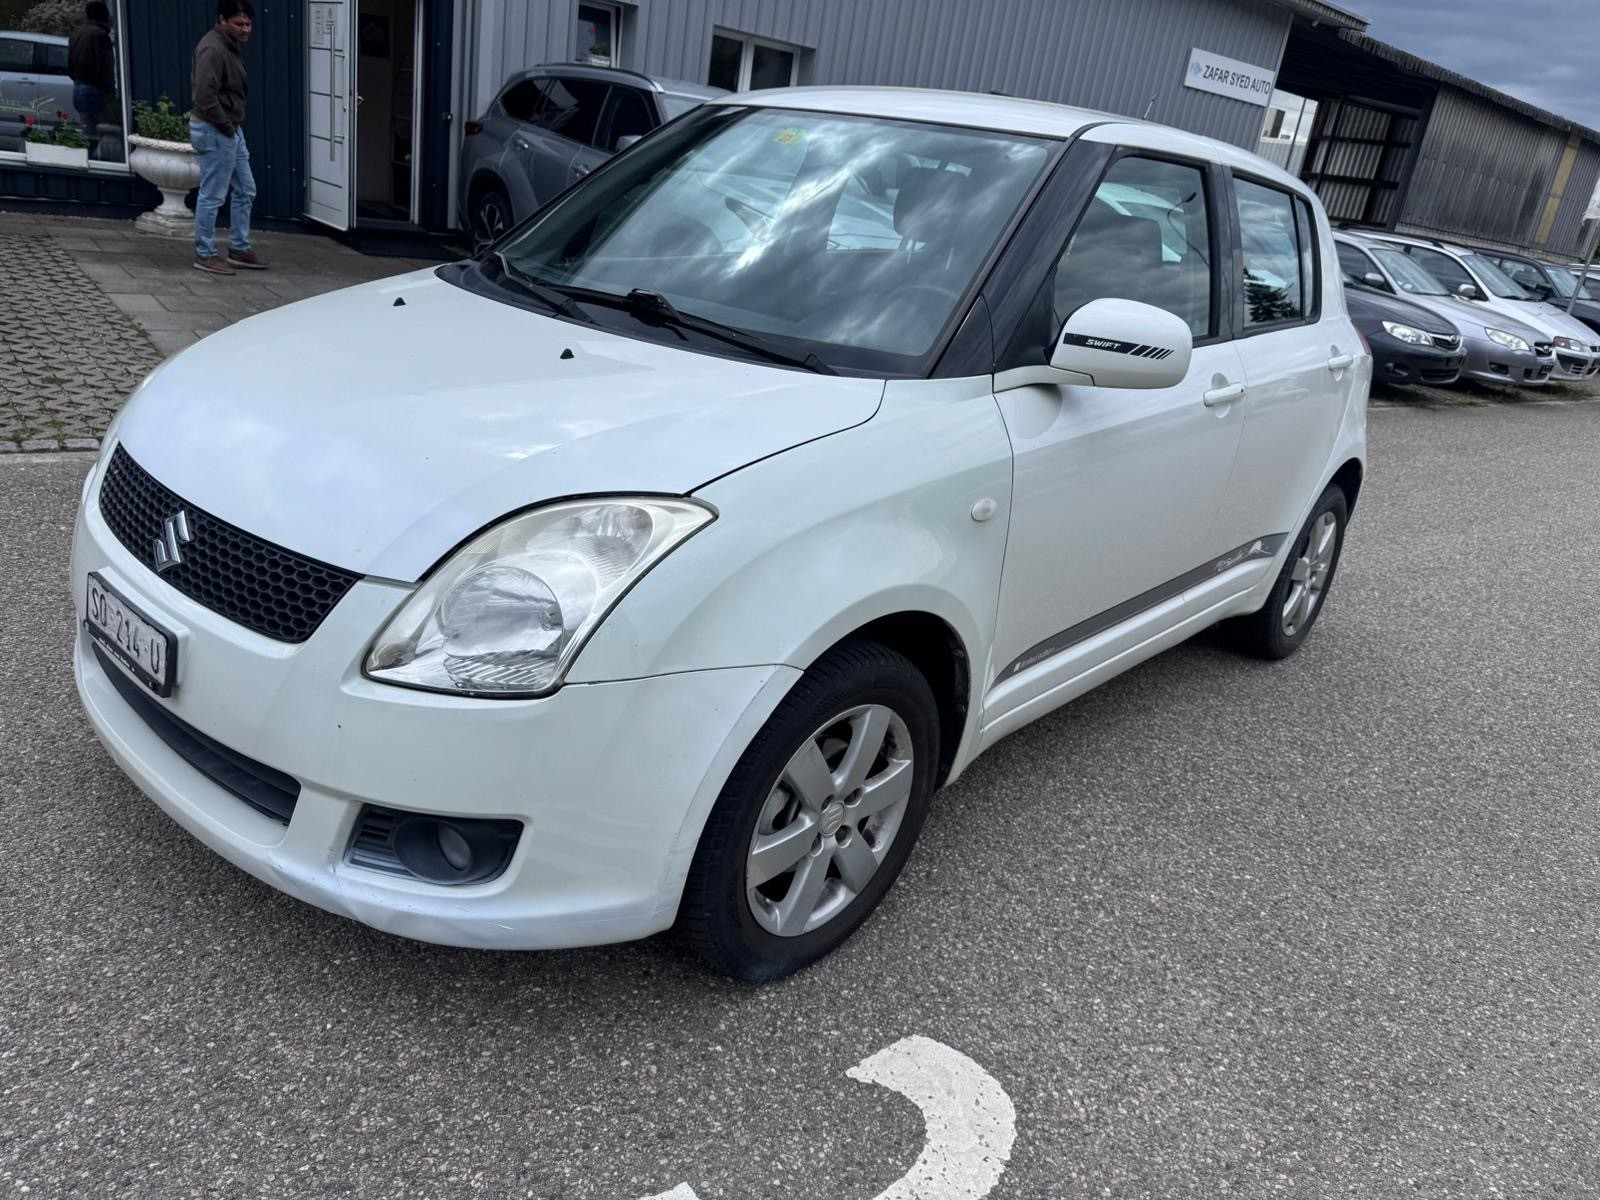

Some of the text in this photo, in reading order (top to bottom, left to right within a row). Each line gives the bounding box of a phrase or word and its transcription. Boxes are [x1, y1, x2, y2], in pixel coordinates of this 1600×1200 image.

[1203, 65, 1271, 95] ZAFAR SYED AUTO
[1085, 339, 1121, 349] SWIFT
